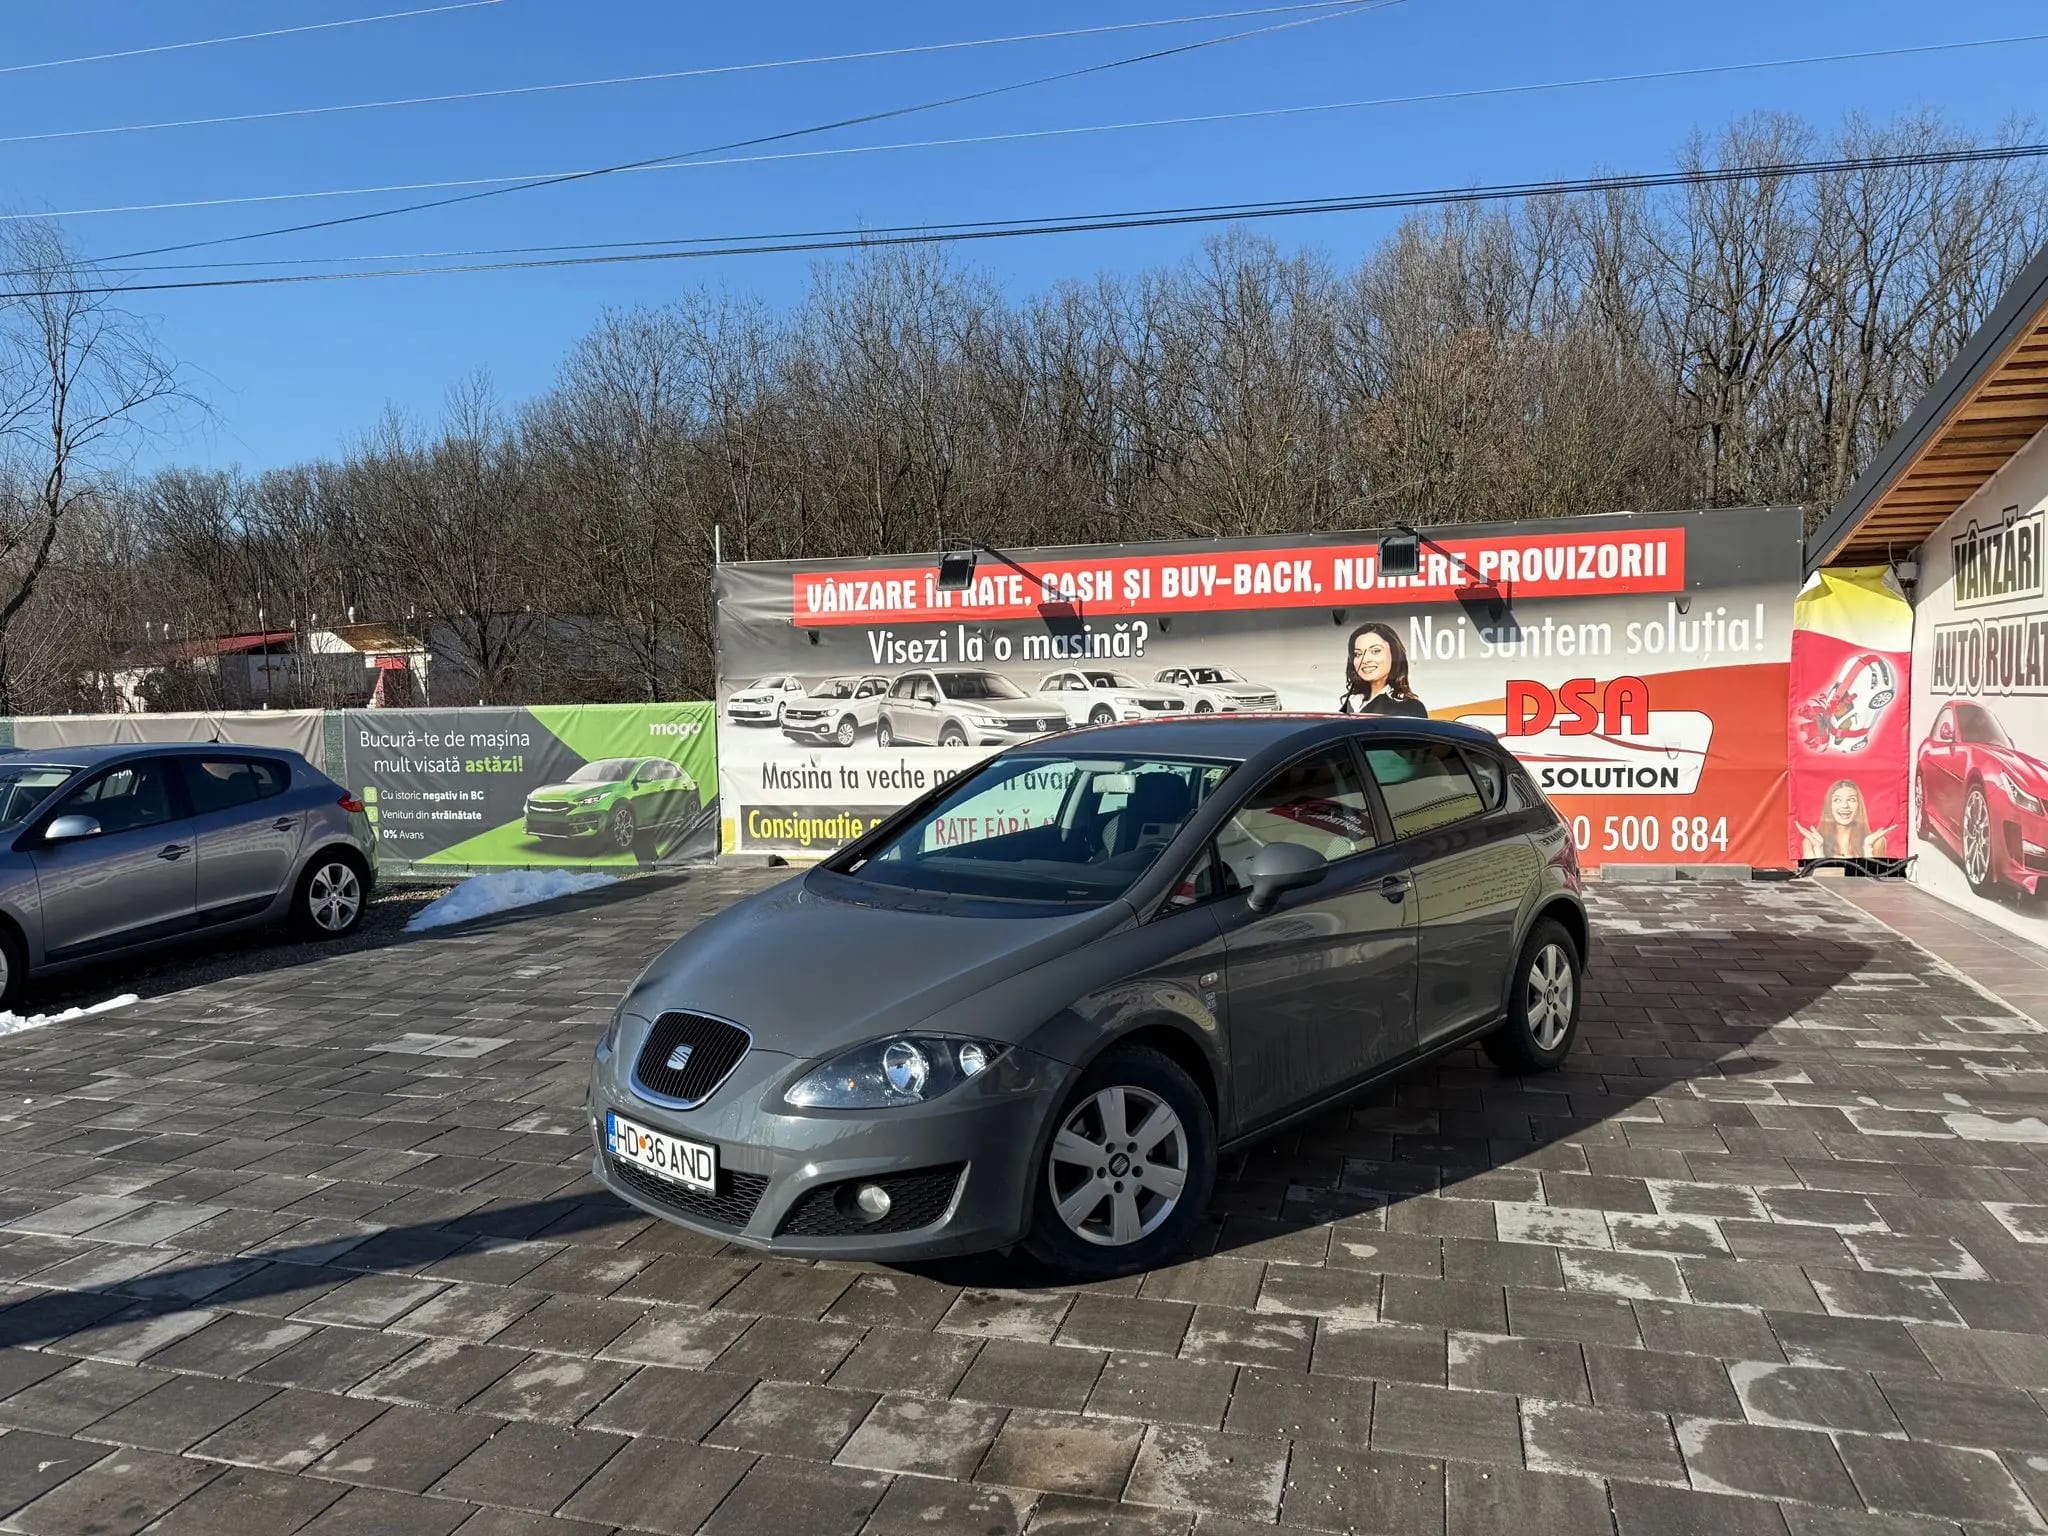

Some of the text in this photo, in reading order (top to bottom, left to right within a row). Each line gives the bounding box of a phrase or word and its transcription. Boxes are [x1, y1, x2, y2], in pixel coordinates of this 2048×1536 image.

[1954, 516, 2041, 602] VÂNZĂRI
[806, 577, 916, 613] VÂNZARE
[961, 574, 1032, 607] RATE,
[1041, 570, 1113, 603] CASH
[1123, 568, 1150, 607] ȘI
[1161, 560, 1322, 598] BUY-BACK,
[1479, 541, 1667, 582] PROVIZORII
[867, 620, 1148, 667] Visezi la o mașină?
[1410, 602, 1764, 661] Noi suntem soluția!
[1933, 628, 1982, 688] AUTO
[1506, 676, 1649, 736] DSA
[360, 730, 530, 750] Bucură-te de mașina
[649, 722, 702, 741] mogo
[374, 755, 524, 773] mult visată astăzi!
[840, 766, 858, 788] ta
[867, 758, 925, 789] veche
[1541, 767, 1679, 788] SOLUTION
[380, 790, 393, 800] Cu
[395, 790, 421, 800] istoric
[423, 791, 457, 802] negativ
[470, 790, 484, 800] BC
[381, 809, 414, 820] Venituri
[416, 810, 429, 820] din
[749, 810, 863, 846] Consignație
[383, 829, 424, 839] 0% Avans
[936, 818, 977, 845] RATE
[1603, 816, 1659, 851] 500
[1671, 816, 1728, 852] 884
[616, 1120, 639, 1156] HD
[645, 1134, 666, 1167] 36
[671, 1142, 711, 1181] AND
